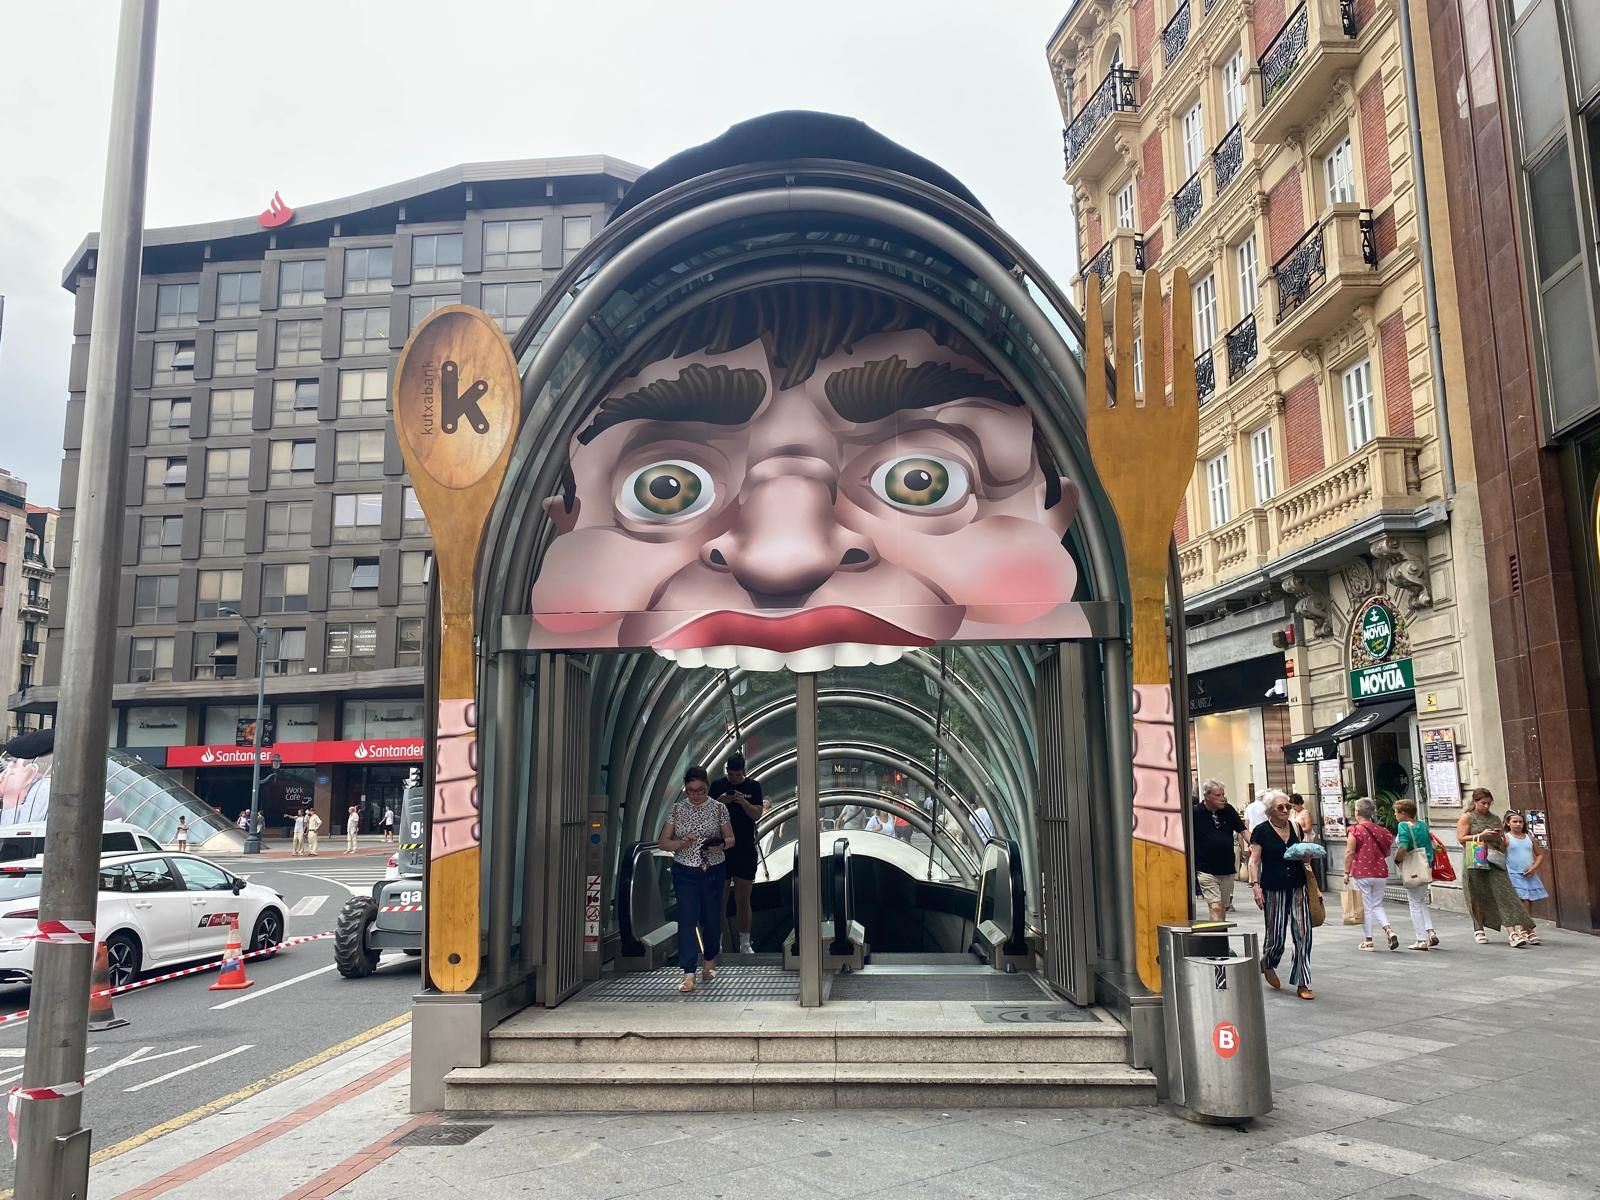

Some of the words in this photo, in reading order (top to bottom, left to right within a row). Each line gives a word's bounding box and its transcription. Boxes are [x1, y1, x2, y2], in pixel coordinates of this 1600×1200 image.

[421, 361, 434, 435] kutxabank
[1363, 624, 1390, 640] MOYUA
[1360, 669, 1405, 695] MOYUA
[369, 743, 425, 758] Santander
[285, 786, 304, 794] Work
[1219, 1029, 1235, 1049] B
